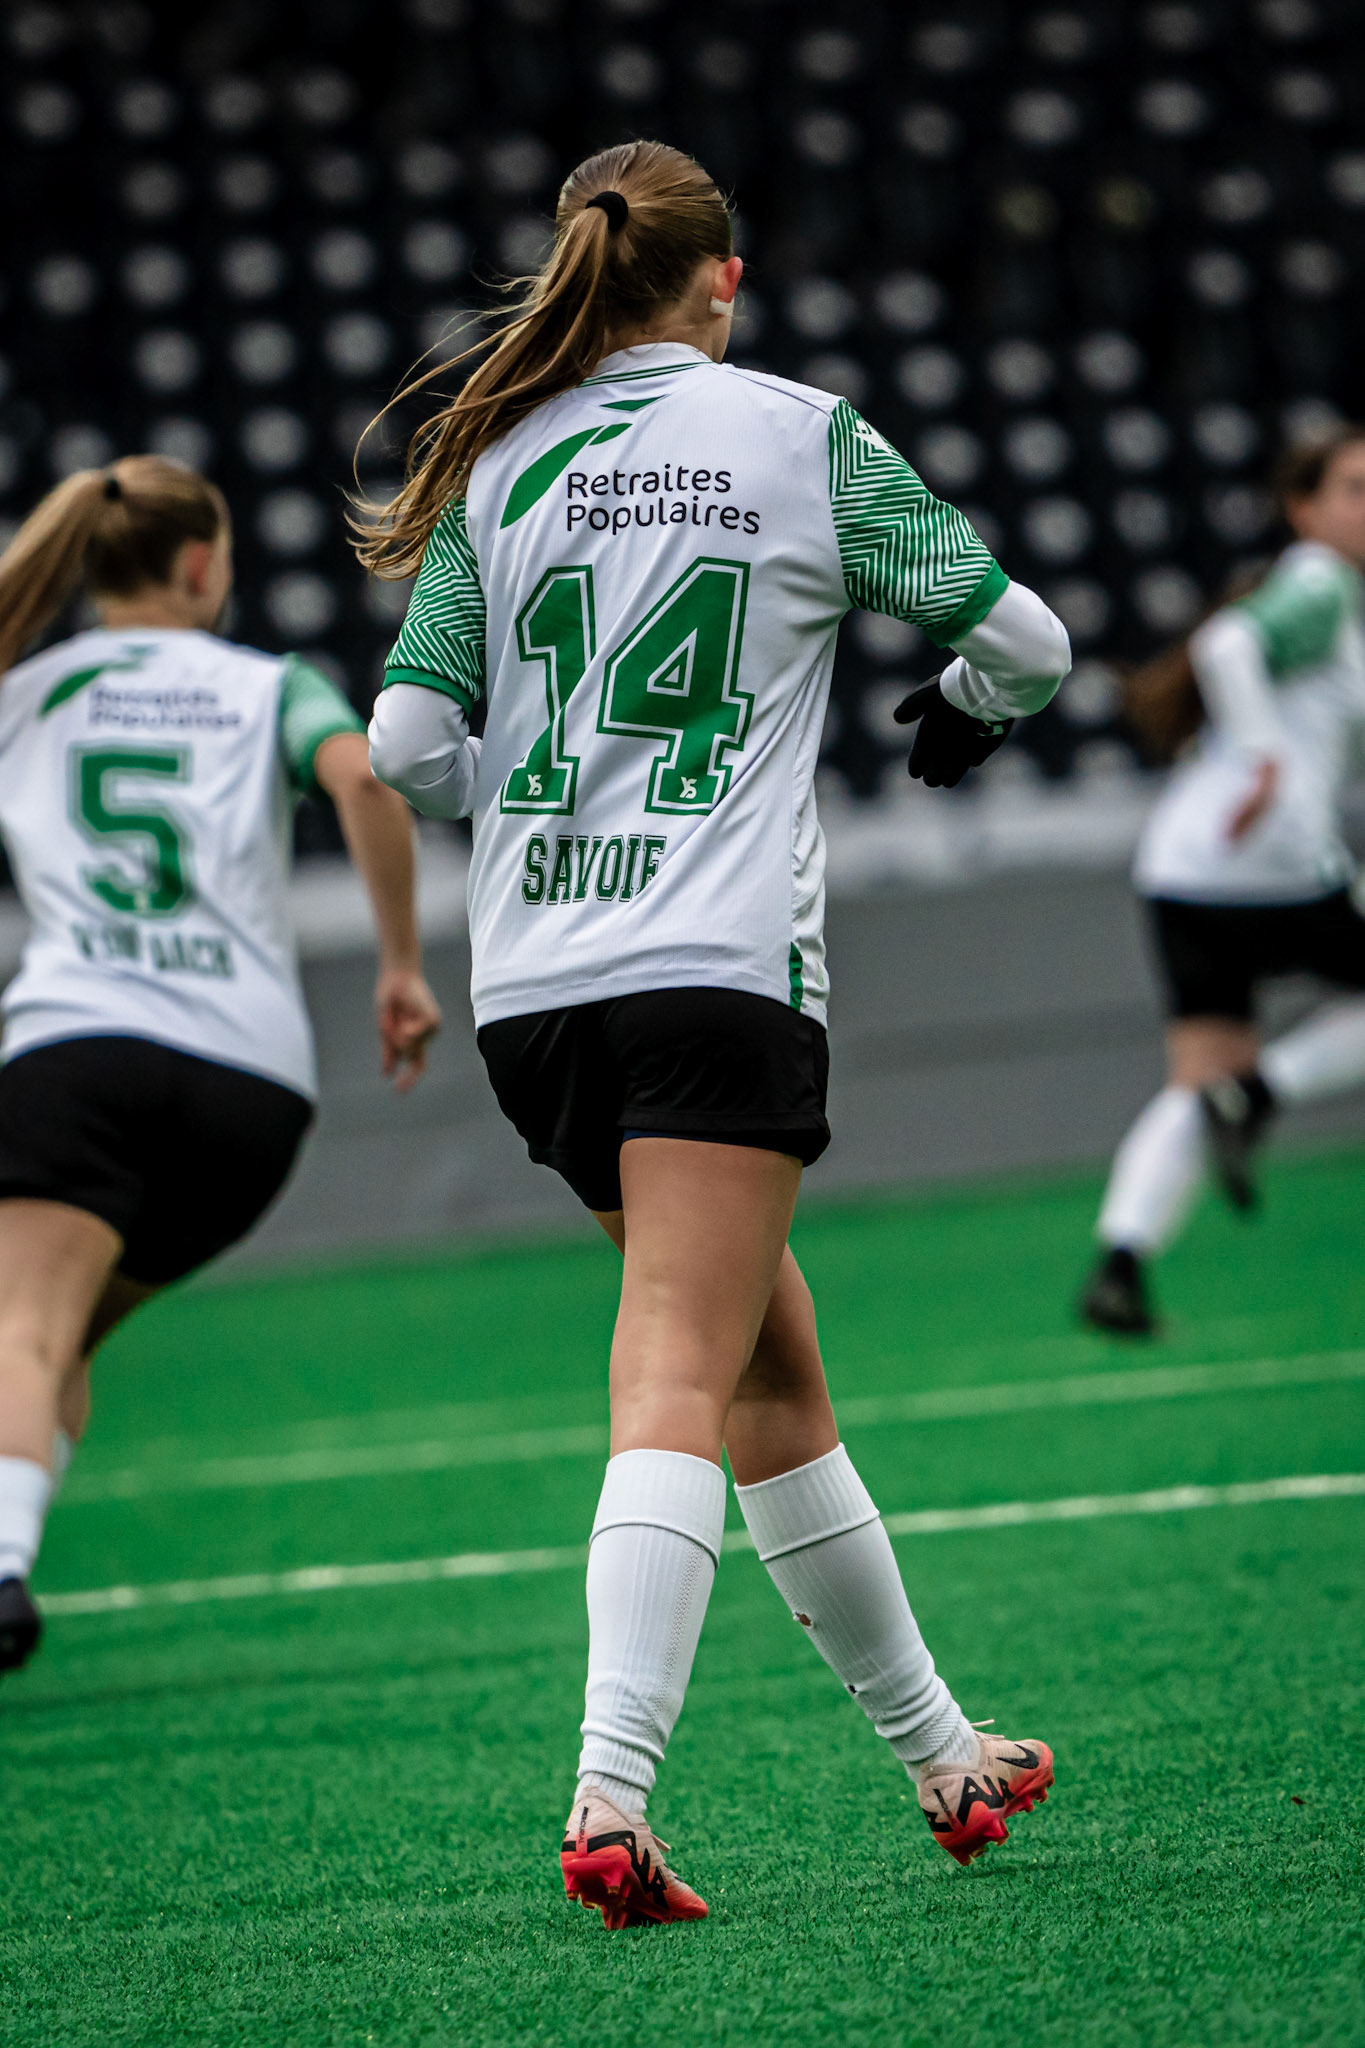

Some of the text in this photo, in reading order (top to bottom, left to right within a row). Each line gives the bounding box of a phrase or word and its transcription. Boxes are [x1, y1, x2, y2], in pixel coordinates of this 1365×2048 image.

[567, 463, 732, 499] Retraites
[567, 495, 761, 536] Populaires
[500, 556, 756, 816] 14
[67, 737, 193, 919] 5
[522, 833, 668, 905] SAVOIE
